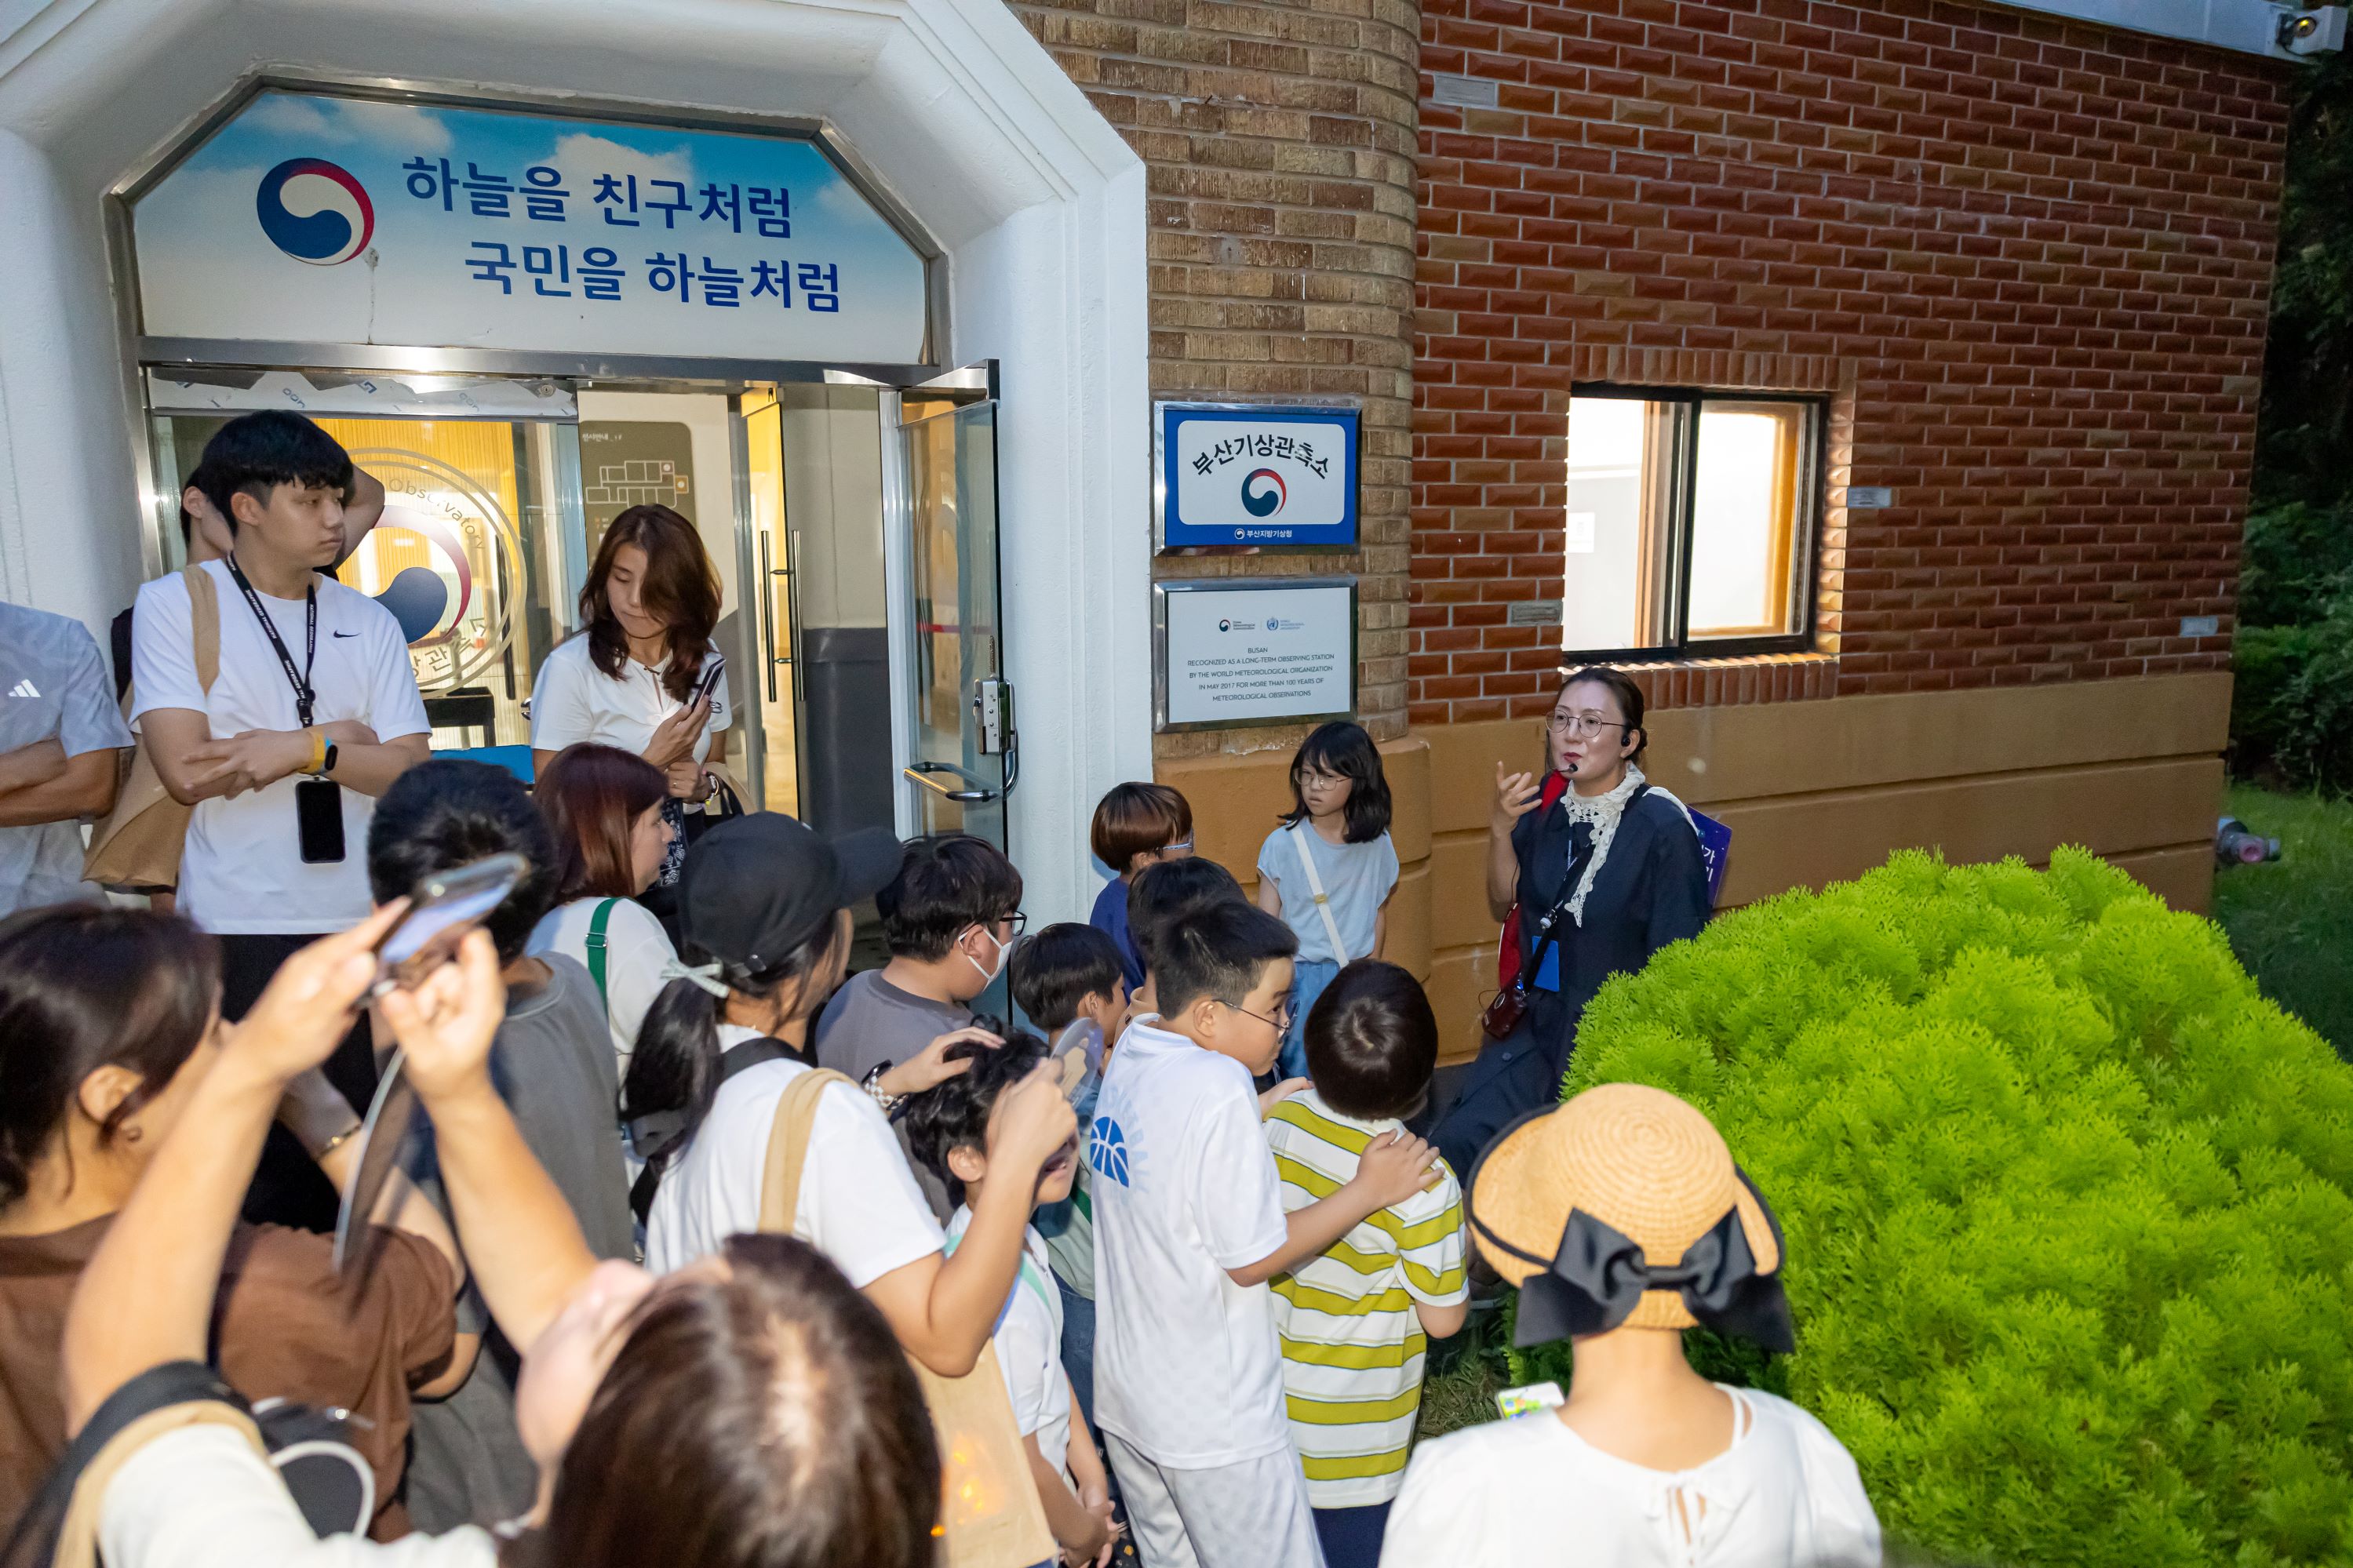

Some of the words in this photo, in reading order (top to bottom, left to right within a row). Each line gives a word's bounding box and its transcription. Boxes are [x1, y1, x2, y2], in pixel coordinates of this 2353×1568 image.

[402, 156, 570, 222] 하늘을
[592, 173, 791, 238] 친구처럼
[465, 242, 625, 301] 국민을
[645, 252, 839, 312] 하늘처럼
[1192, 434, 1328, 480] 부산기상관측소
[389, 478, 485, 550] Obsvatory
[1247, 529, 1292, 538] 부산지방기상청
[245, 589, 264, 617] GEOGRAPHIC
[262, 614, 277, 639] NATIONAL
[1290, 665, 1333, 674] ORGANIZATION
[1212, 692, 1268, 702] METEOROLOGICAL
[1269, 689, 1312, 698] OBSERVATIONS
